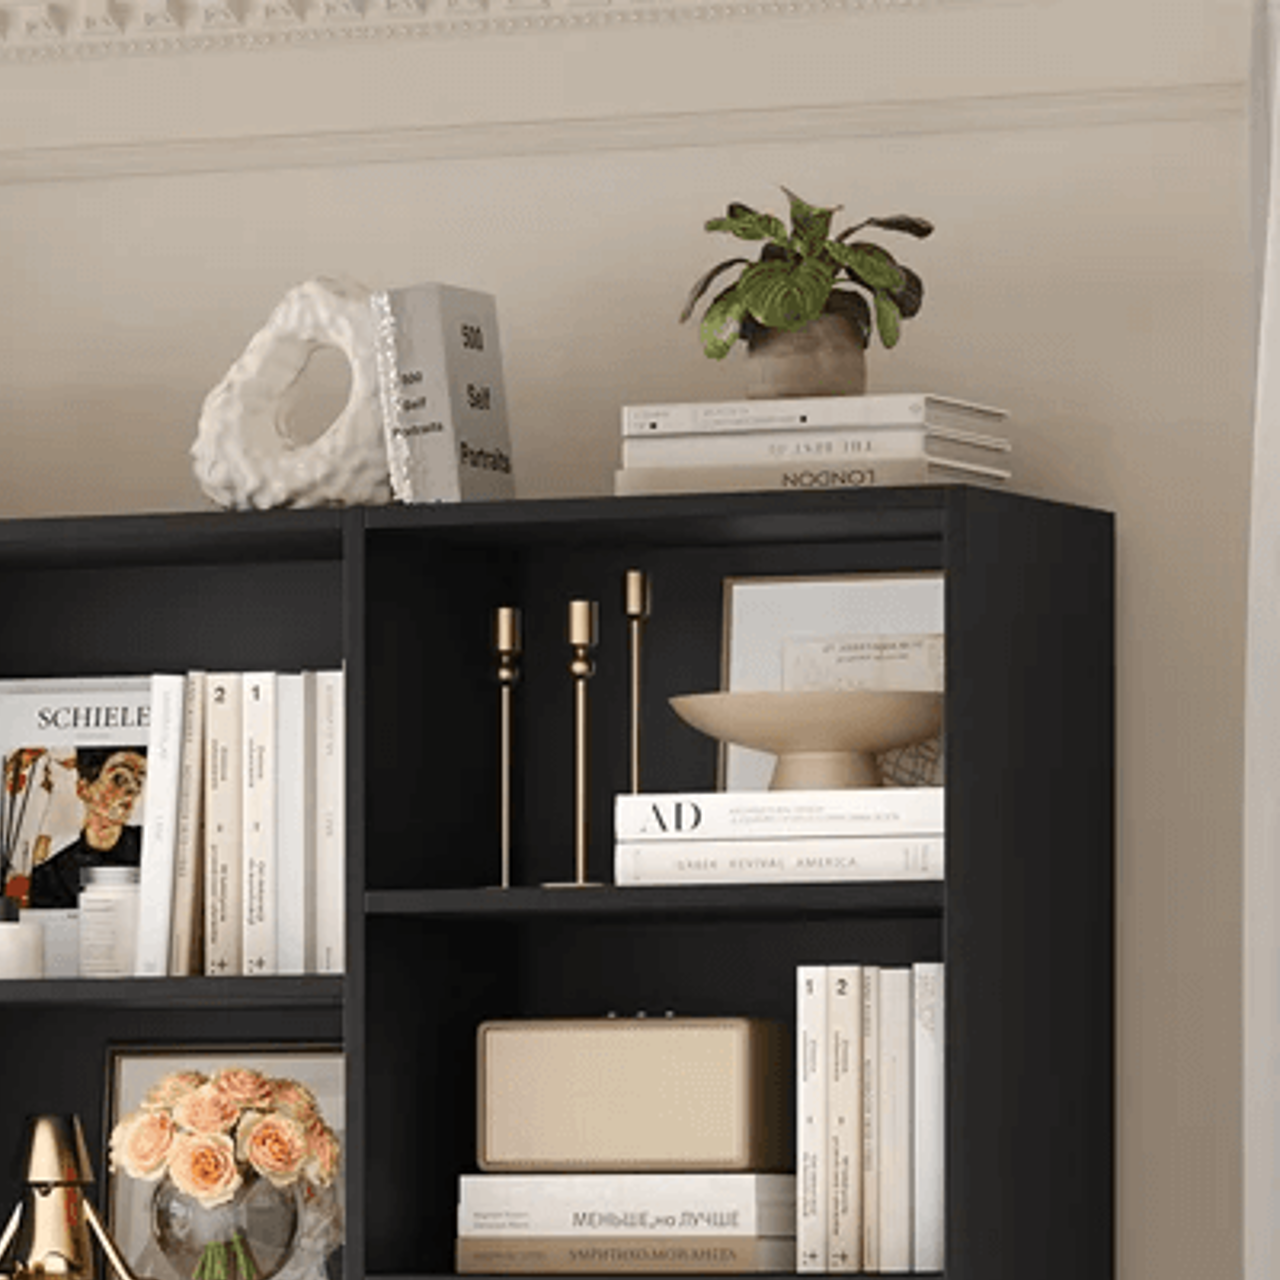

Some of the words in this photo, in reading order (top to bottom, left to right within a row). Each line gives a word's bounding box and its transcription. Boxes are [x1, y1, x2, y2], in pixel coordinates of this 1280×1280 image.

[461, 322, 484, 351] 500
[466, 383, 491, 411] Self
[460, 440, 513, 475] Portraits
[780, 469, 877, 487] LONDON
[37, 705, 151, 730] SCHIELE
[640, 801, 702, 832] AD
[796, 856, 859, 869] AMERICA
[678, 1211, 740, 1227] ЛУЧШЕ
